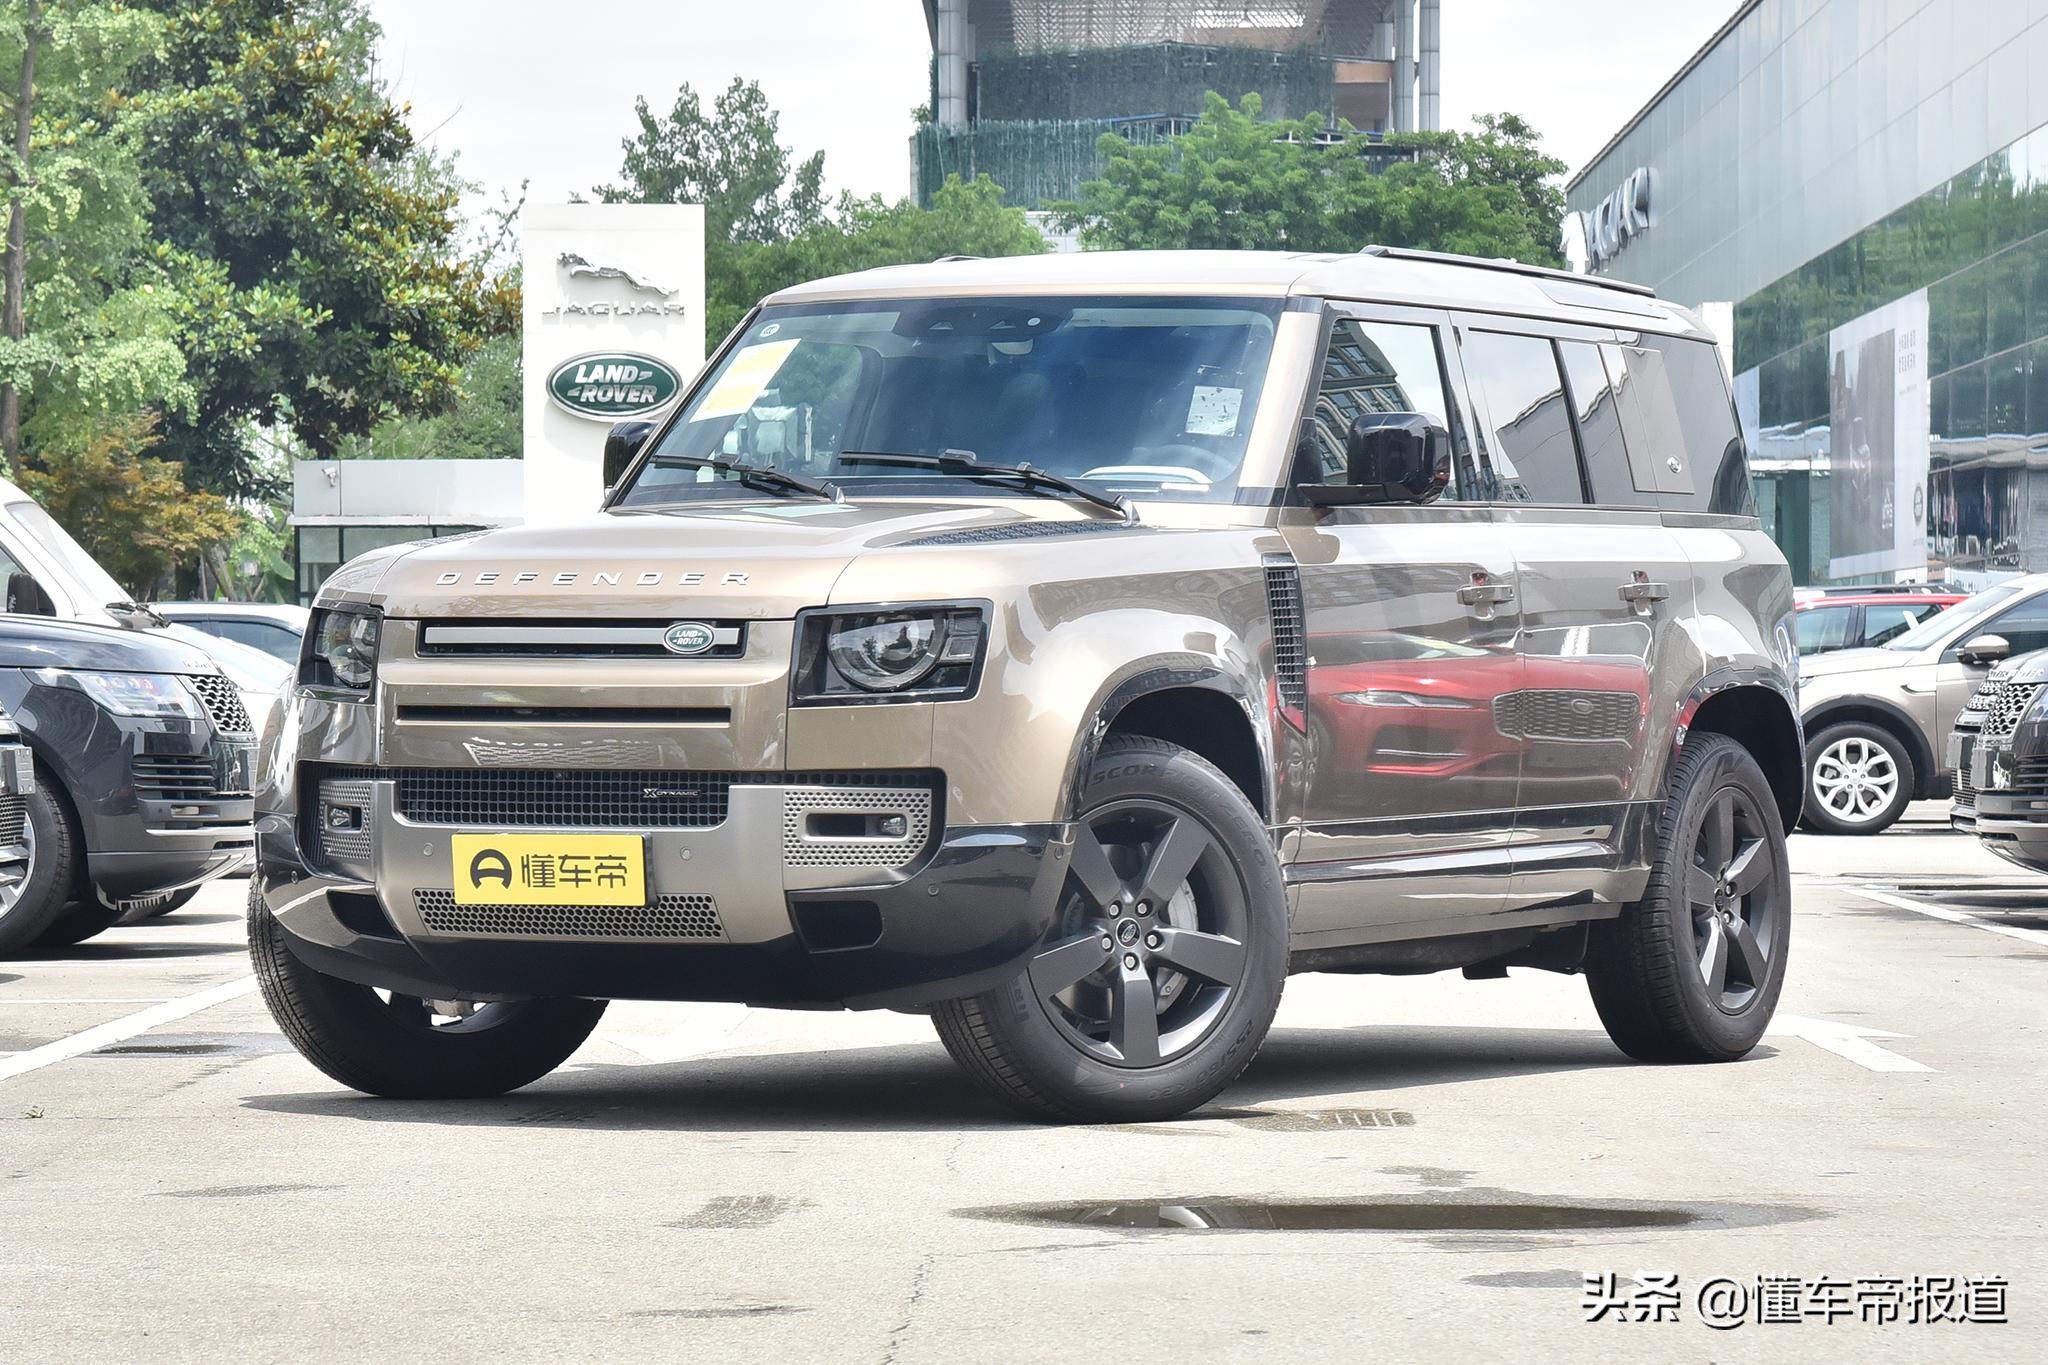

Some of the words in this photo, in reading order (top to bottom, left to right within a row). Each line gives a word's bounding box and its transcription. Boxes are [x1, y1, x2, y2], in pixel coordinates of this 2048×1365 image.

[435, 571, 751, 586] DEFENDER
[520, 853, 628, 889] 懂车帝
